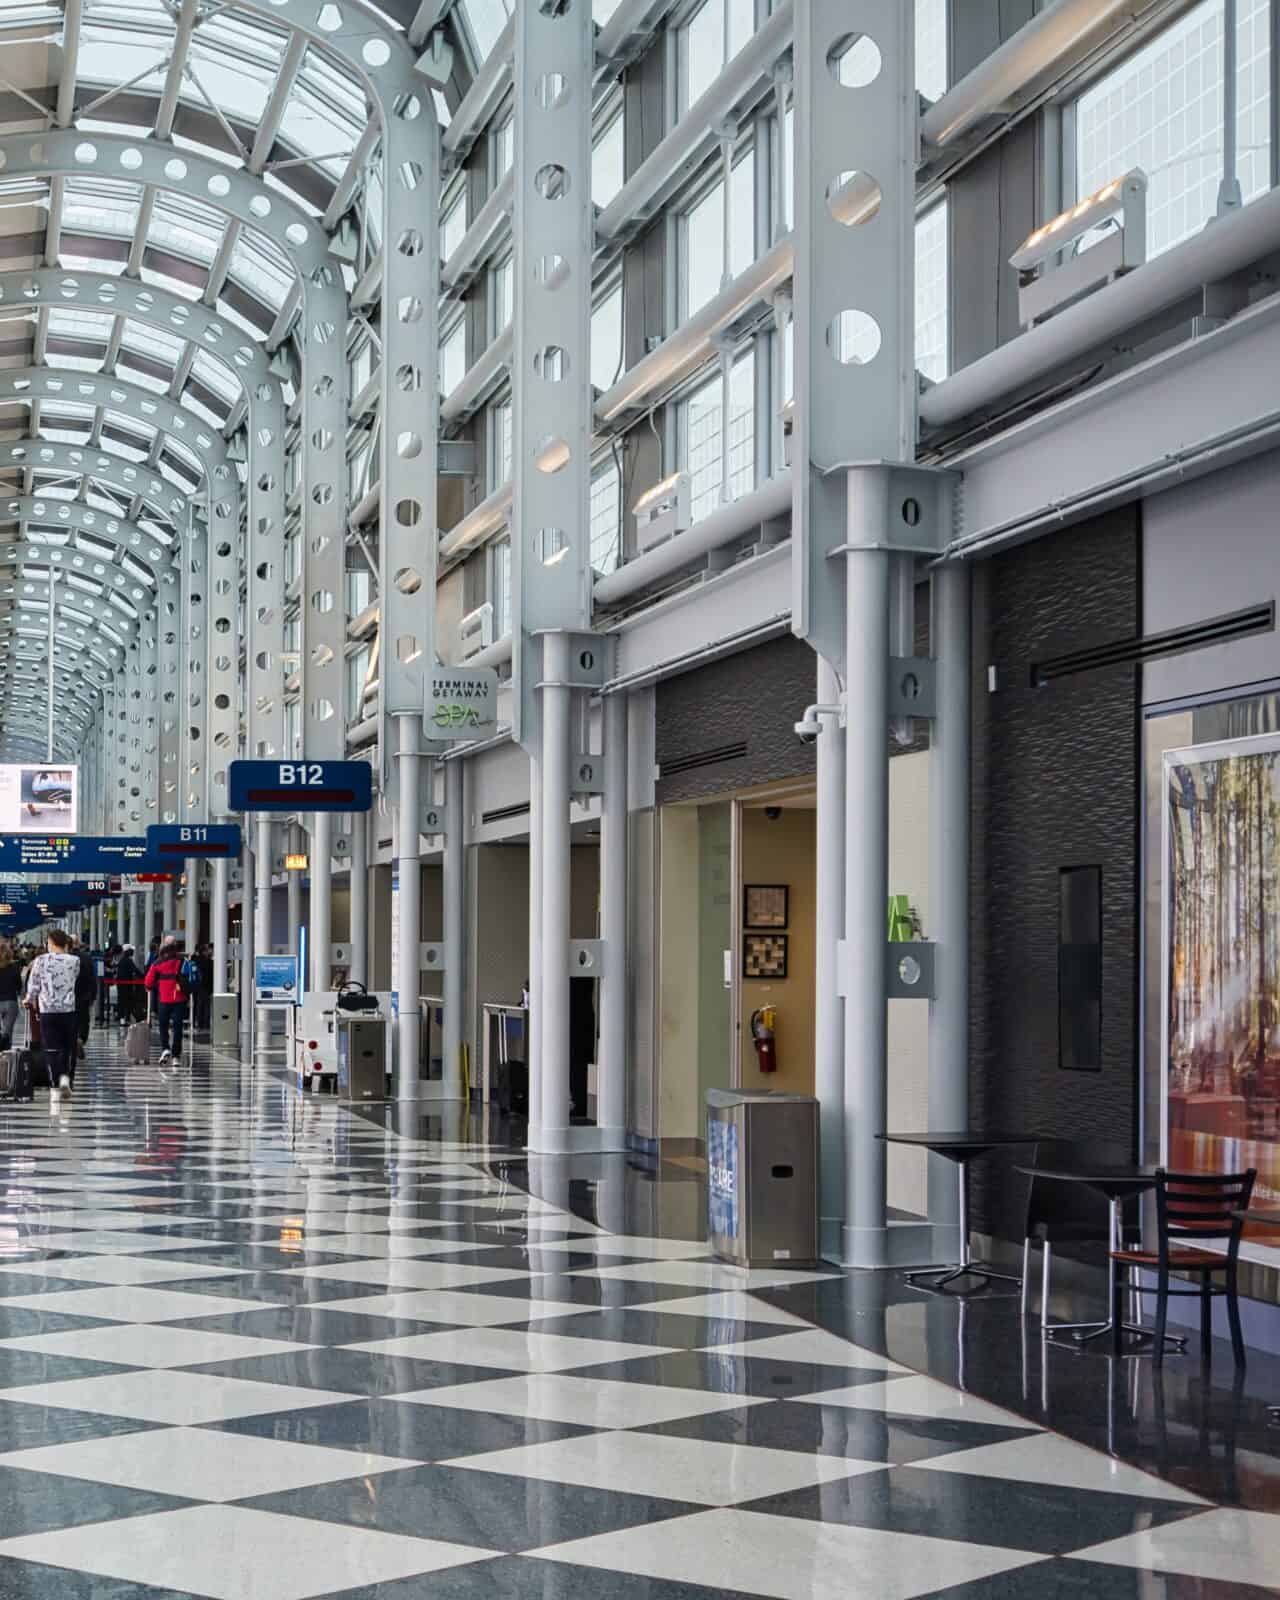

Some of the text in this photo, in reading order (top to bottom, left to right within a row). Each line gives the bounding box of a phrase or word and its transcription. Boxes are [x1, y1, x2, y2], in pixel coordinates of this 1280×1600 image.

[433, 680, 488, 688] TERMINAL
[433, 689, 488, 697] GETAWAY
[279, 765, 323, 785] B12
[180, 828, 207, 841] B11
[87, 881, 105, 890] B10
